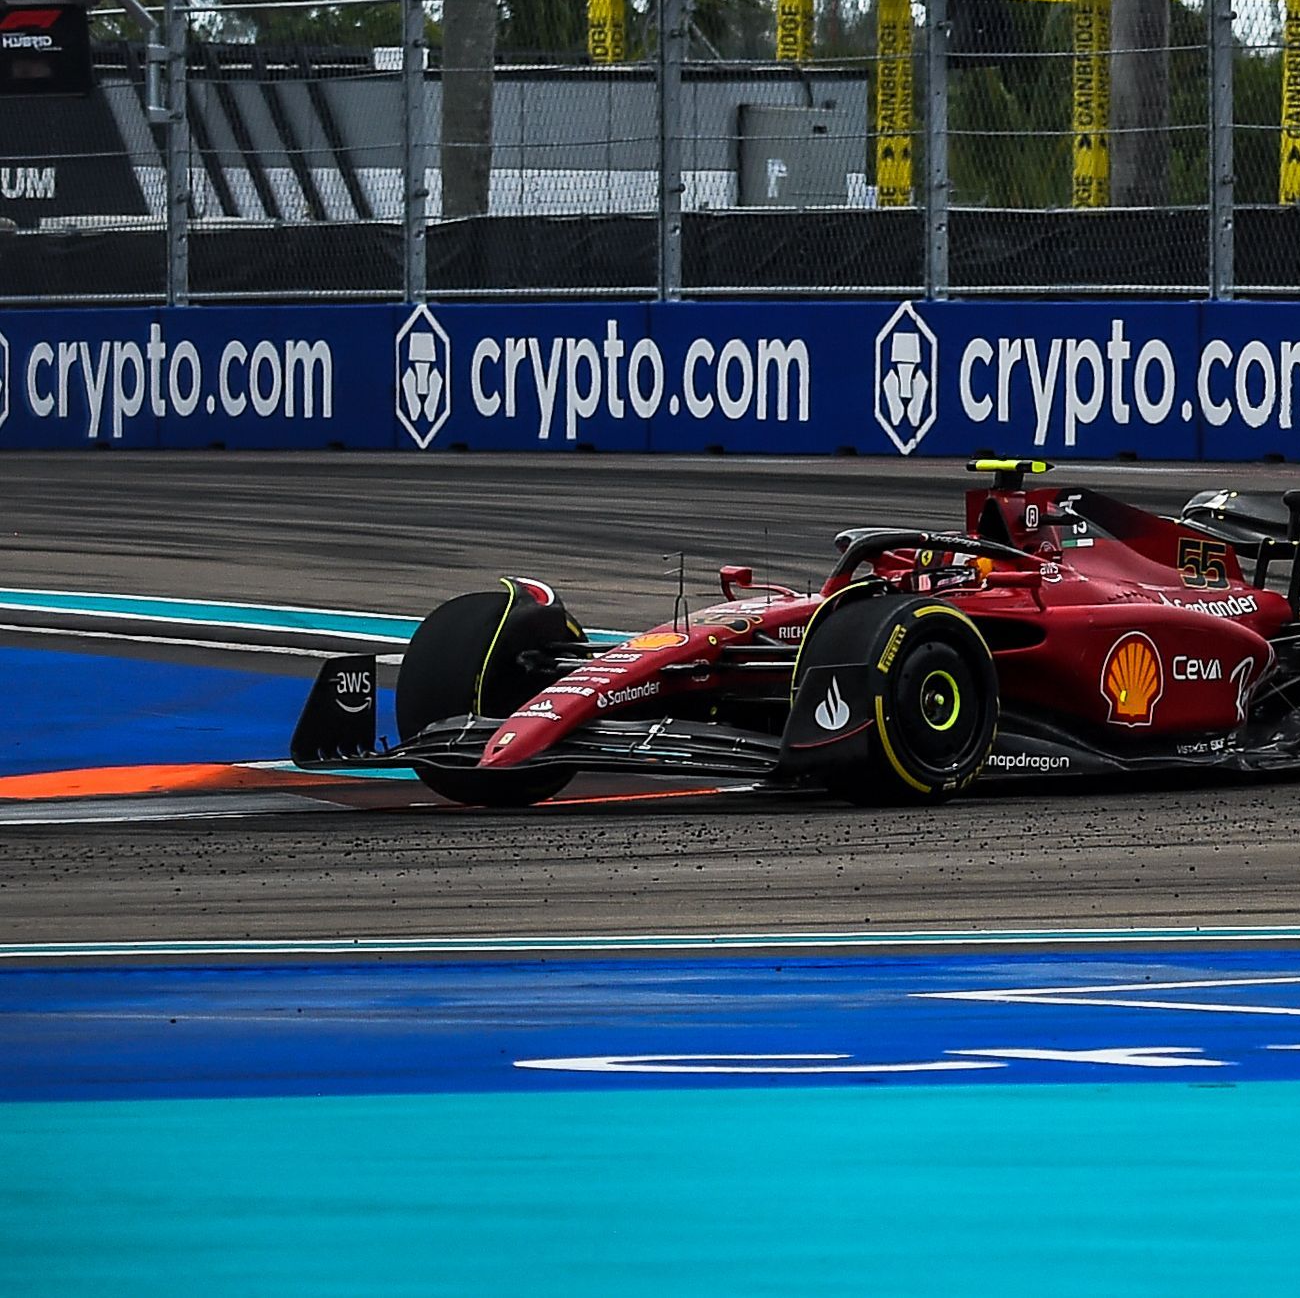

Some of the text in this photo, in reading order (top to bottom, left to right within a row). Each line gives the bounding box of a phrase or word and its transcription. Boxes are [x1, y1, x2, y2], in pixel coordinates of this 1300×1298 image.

[880, 22, 898, 139] GAINBRIDGE
[1075, 4, 1094, 127] GAINBRIDGE
[28, 324, 332, 438] crypto.com
[472, 320, 810, 440] crypto.com
[1177, 537, 1231, 590] 55
[877, 624, 908, 674] PIRELLI
[336, 671, 371, 694] aws
[607, 681, 661, 707] Santander
[985, 752, 1070, 771] napdragon
